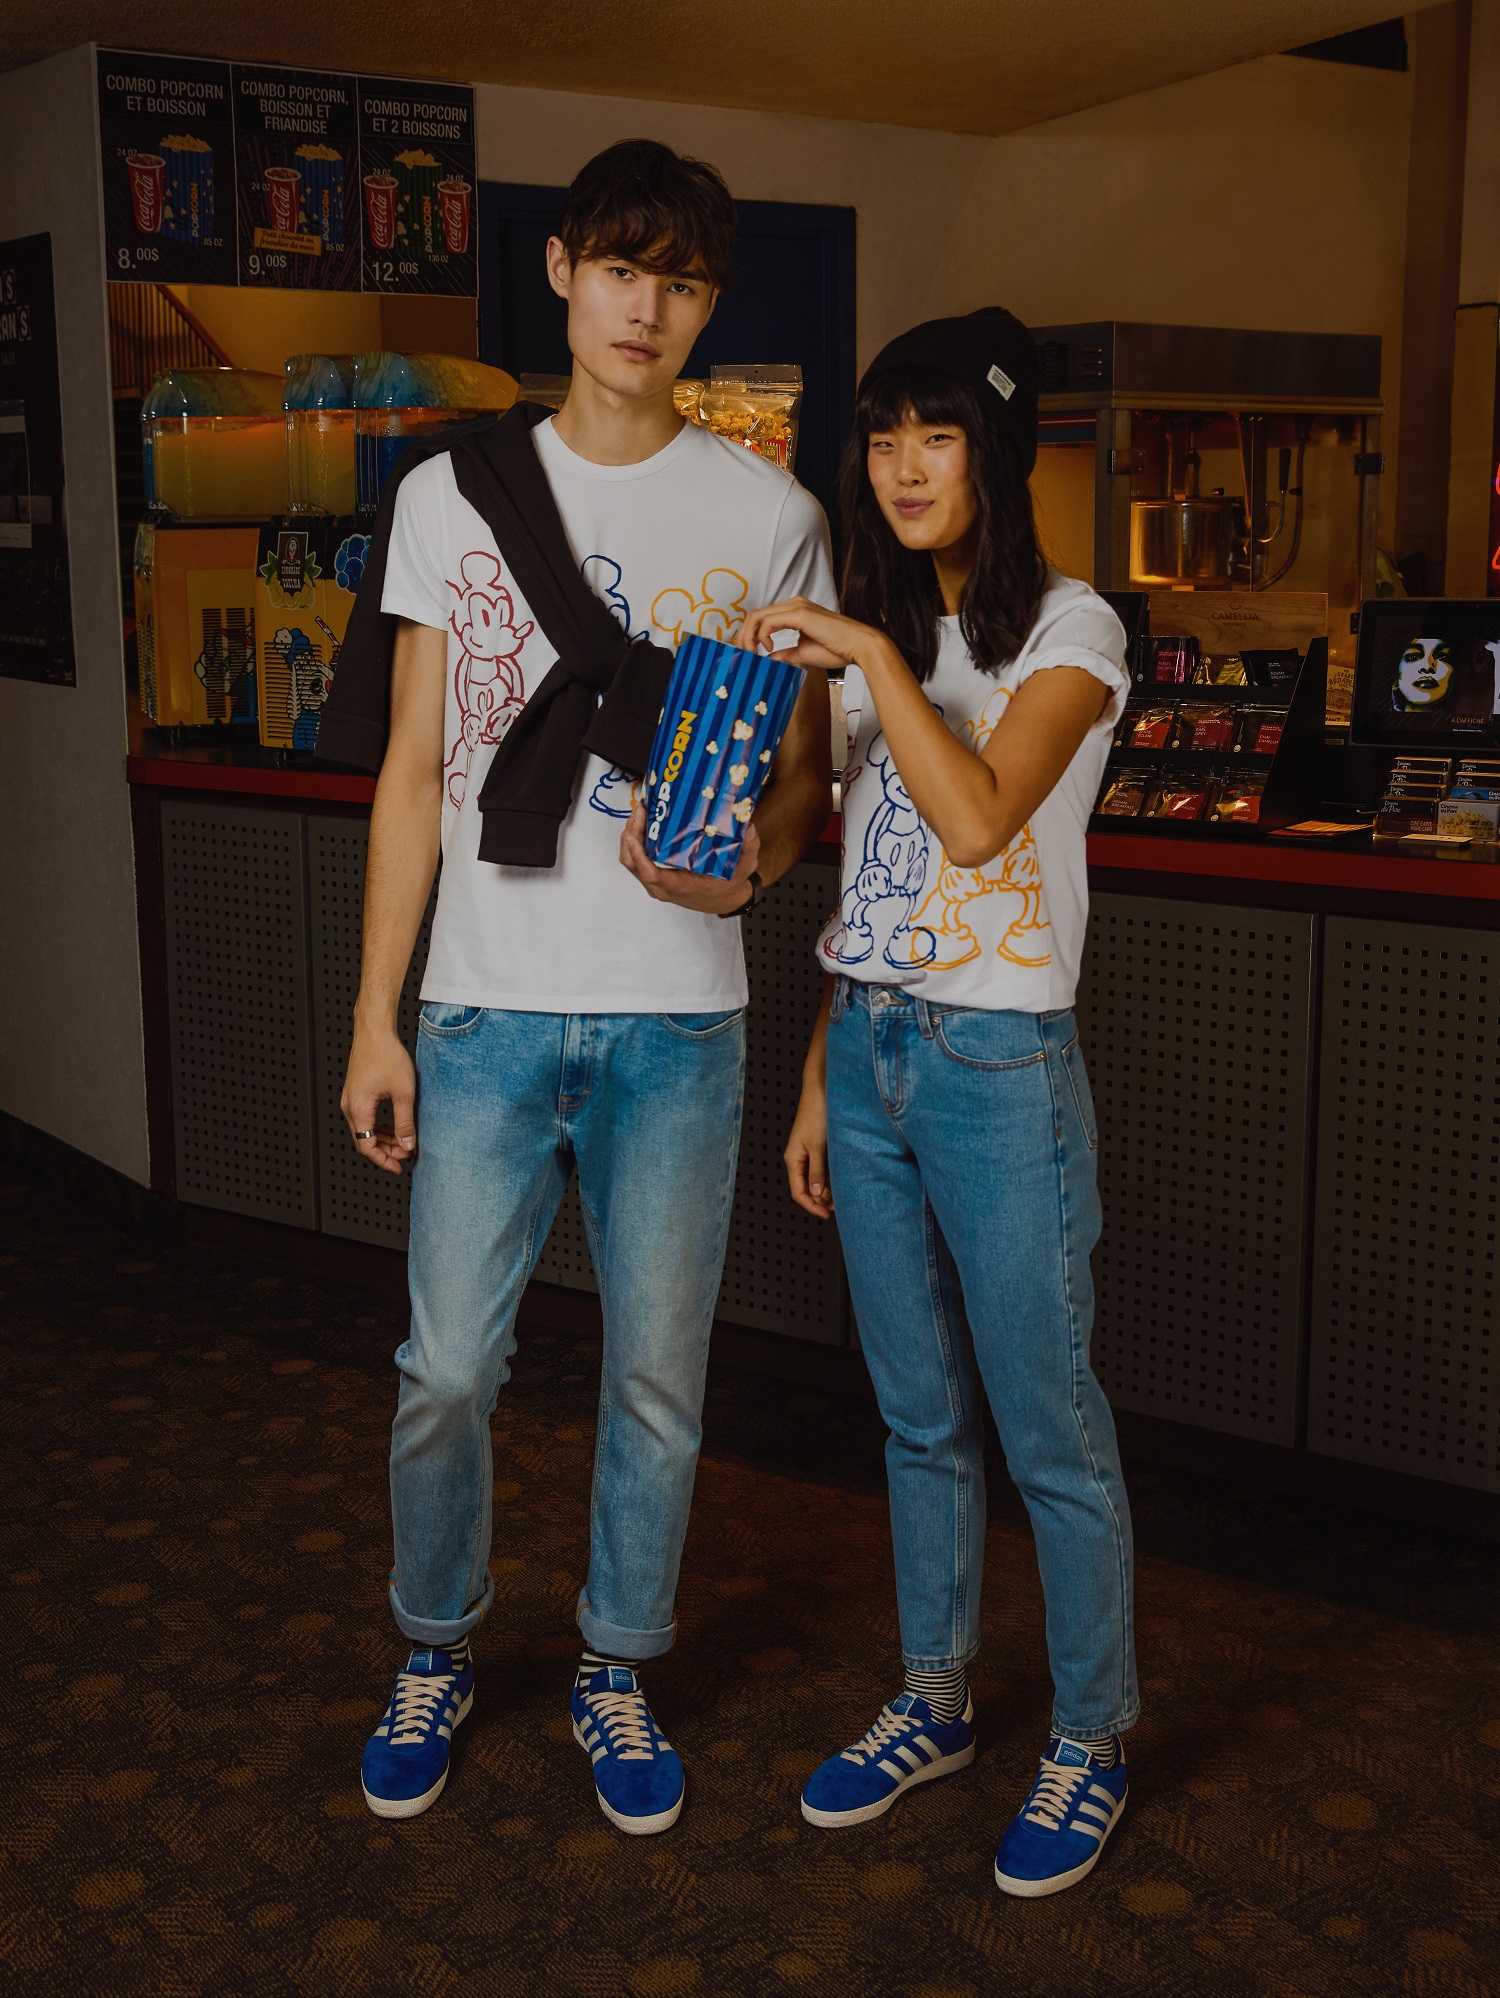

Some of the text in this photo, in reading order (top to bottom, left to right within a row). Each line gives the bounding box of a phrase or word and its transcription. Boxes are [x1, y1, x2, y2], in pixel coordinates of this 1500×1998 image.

[106, 75, 224, 100] COMBO POPCORN
[241, 80, 349, 107] COMBO POPCORN,
[126, 95, 206, 117] ET BOISSON
[260, 98, 331, 118] BOISSON ET
[364, 99, 467, 122] COMBO POPCORN
[264, 115, 328, 134] FRIANDISE
[372, 117, 461, 139] ET 2 BOISSONS
[117, 148, 126, 157] 24
[251, 182, 261, 191] 24
[190, 181, 200, 238] POPCORN
[322, 189, 330, 241] POPCORN
[422, 195, 434, 254] POPCORN
[1211, 612, 1259, 621] CAMELLIA
[648, 709, 698, 842] POPCORN
[1063, 1749, 1084, 1762] adidas
